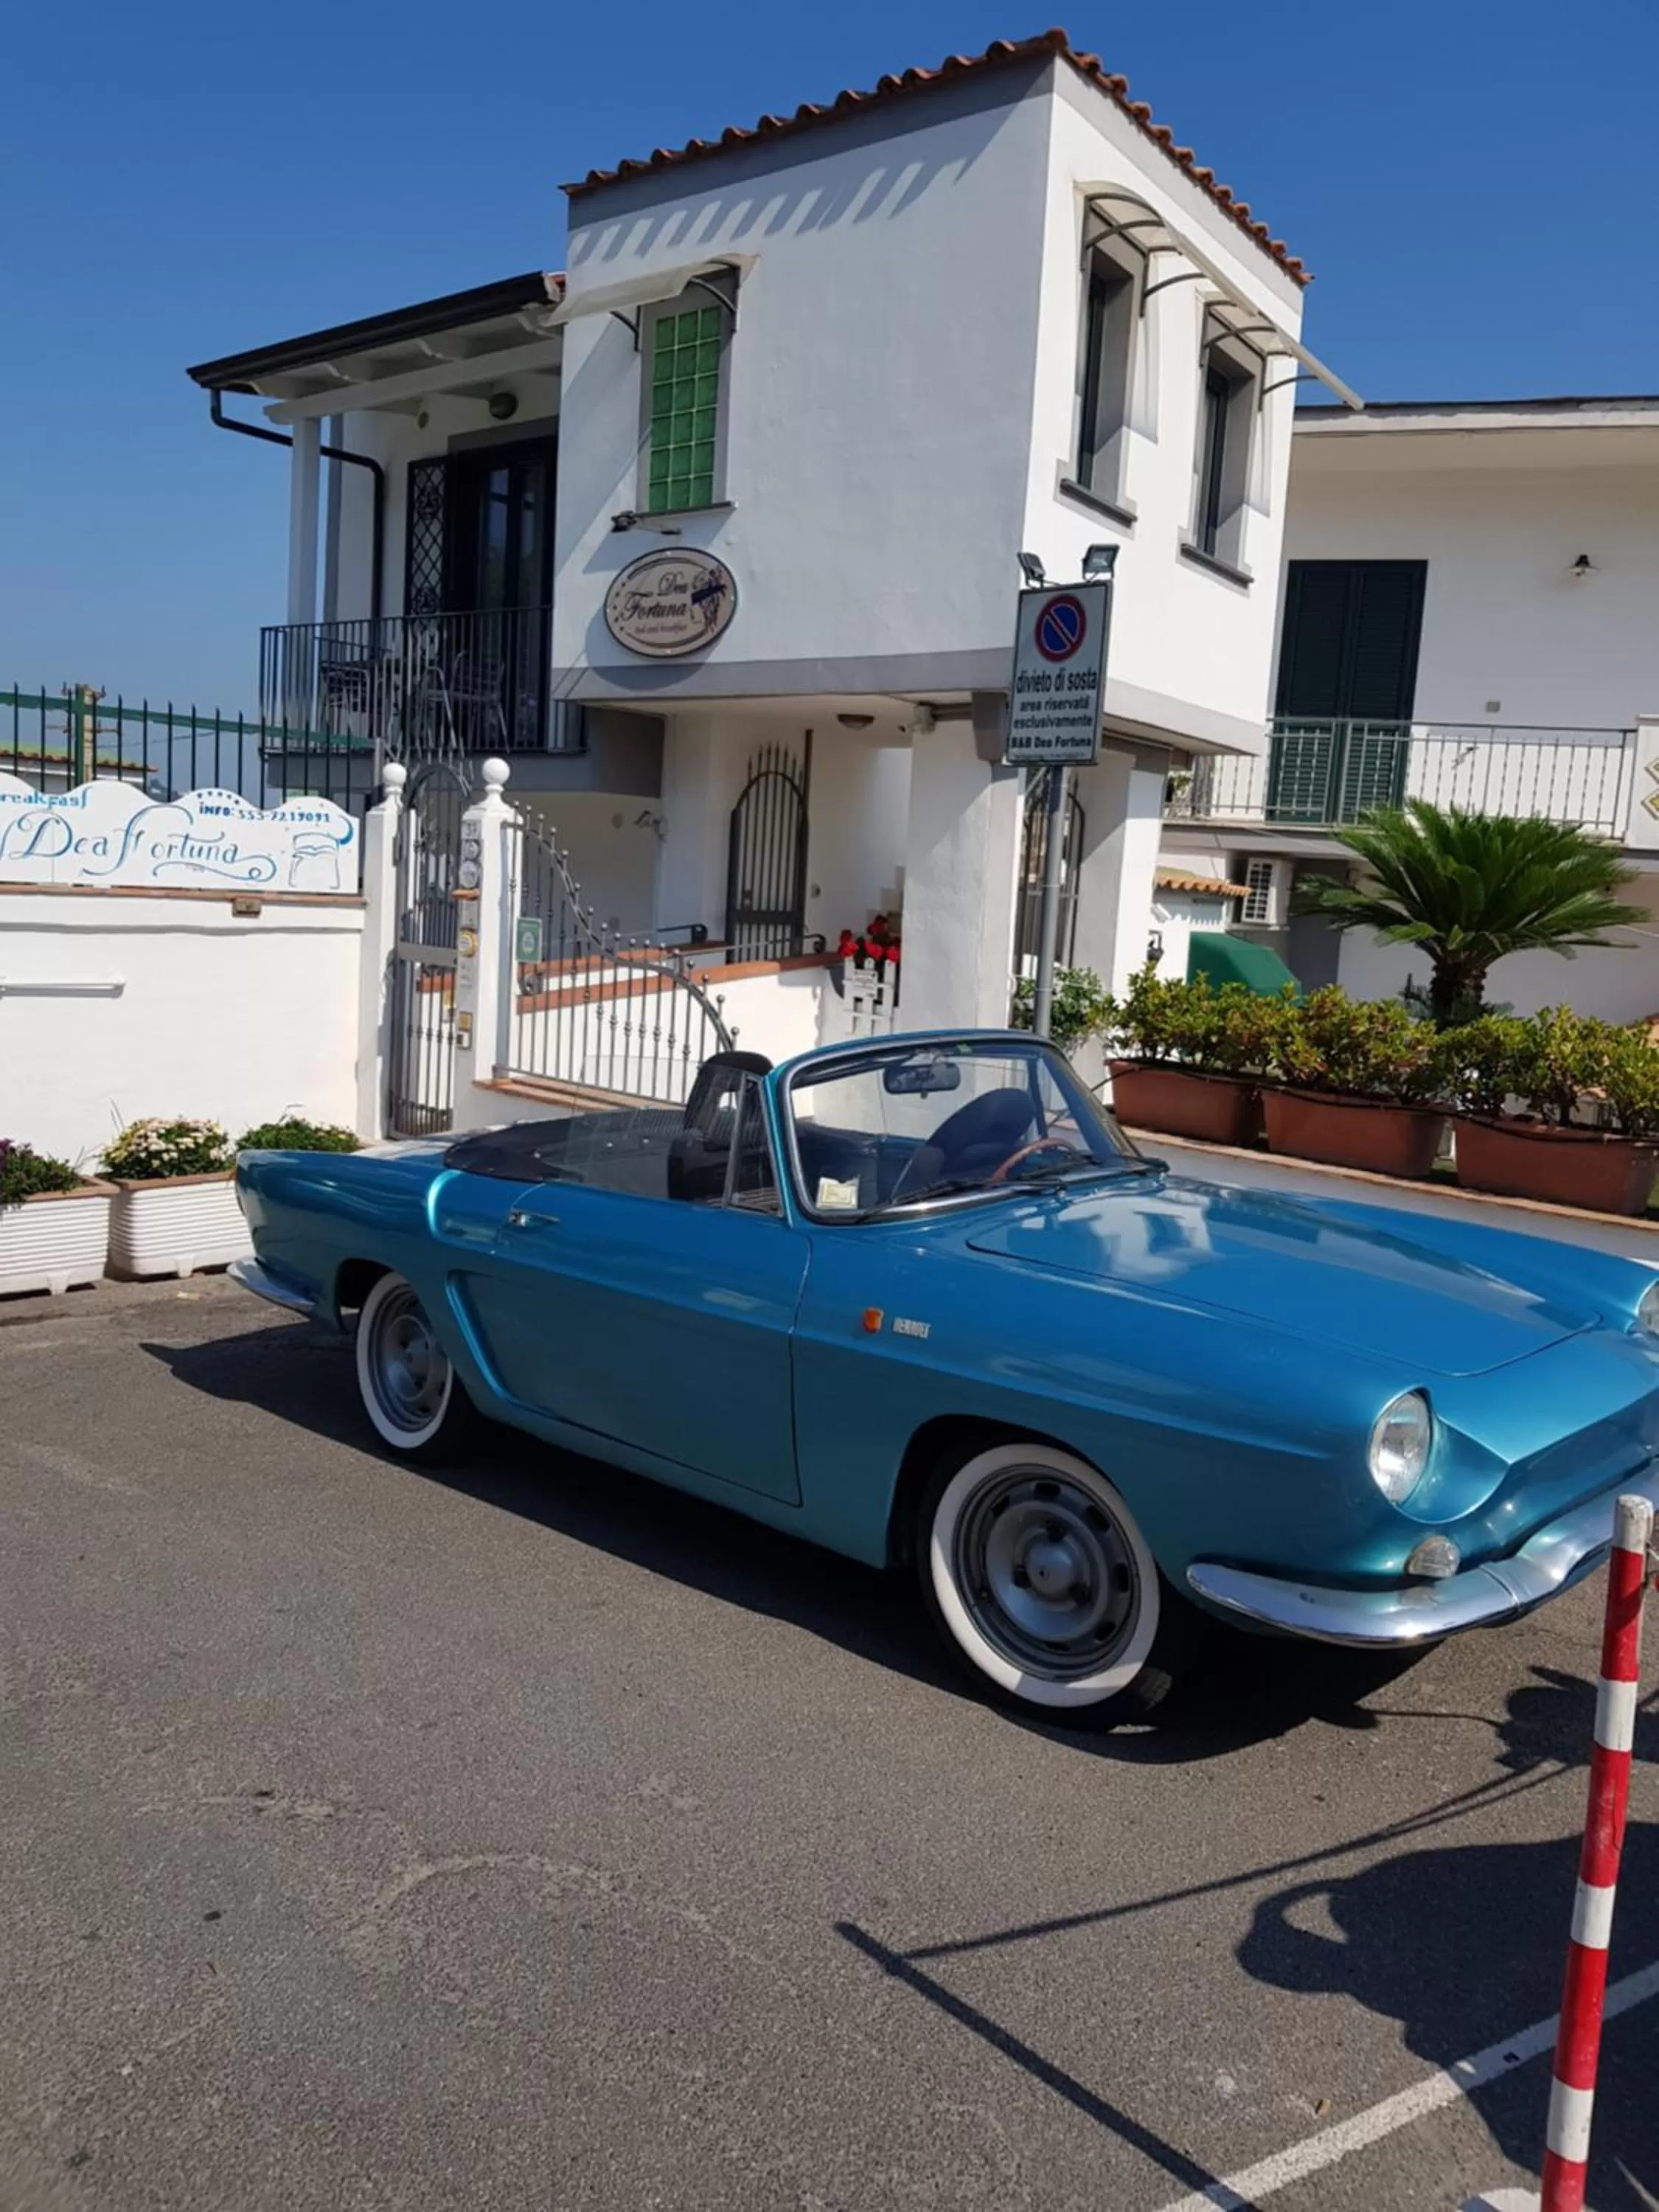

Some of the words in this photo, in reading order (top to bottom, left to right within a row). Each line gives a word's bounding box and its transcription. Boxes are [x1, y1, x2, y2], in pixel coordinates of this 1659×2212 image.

[621, 591, 687, 621] Fortuna
[1017, 669, 1051, 693] divieto
[1054, 667, 1066, 692] di
[1068, 666, 1097, 690] sosta
[1020, 700, 1041, 712] area
[1043, 695, 1089, 711] riservata
[1013, 714, 1092, 729] esclusivamente
[1054, 734, 1091, 748] Fortuna
[0, 786, 93, 810] reakfast
[9, 811, 109, 860] Dea
